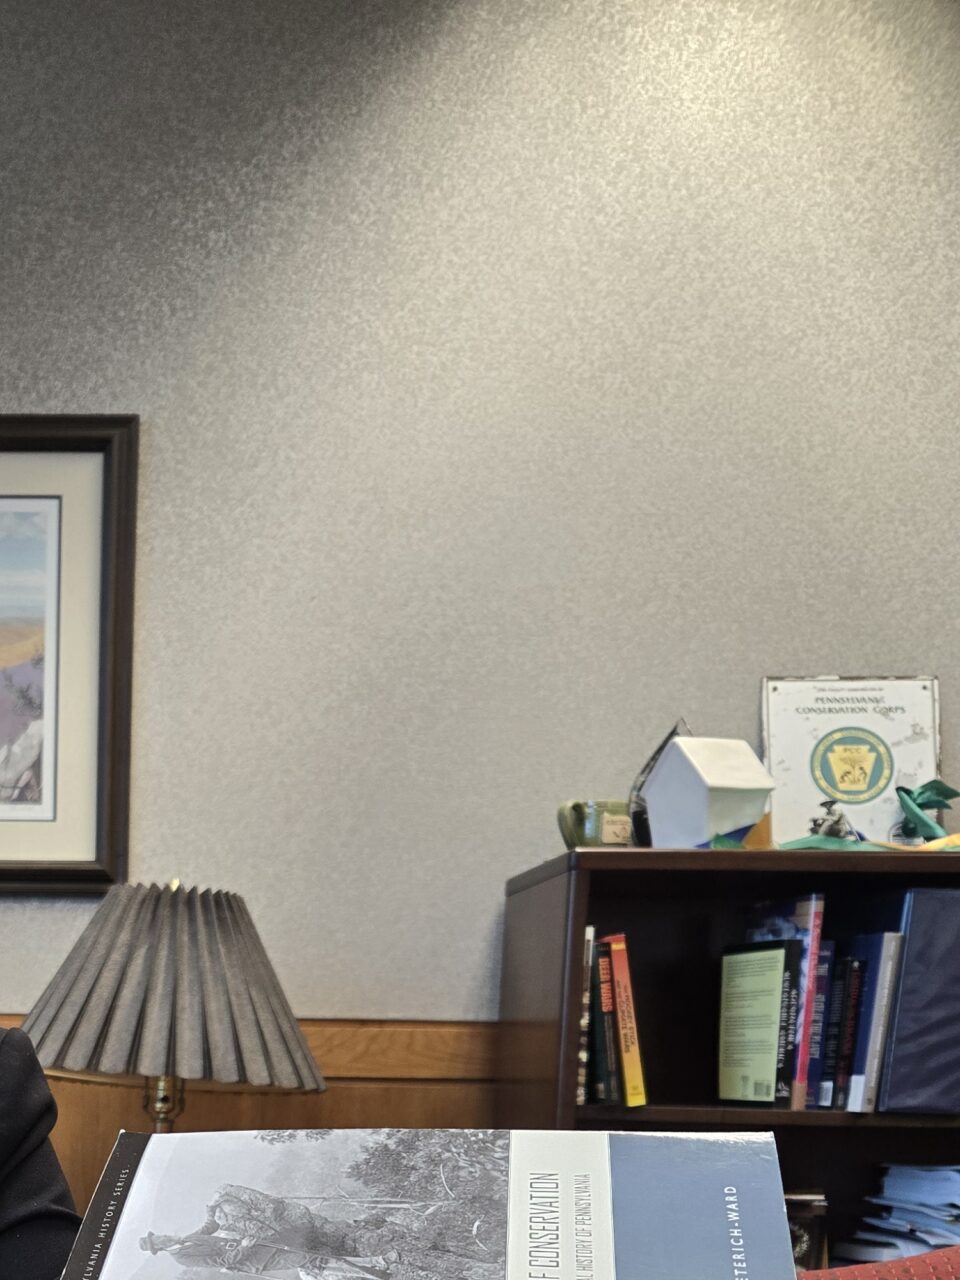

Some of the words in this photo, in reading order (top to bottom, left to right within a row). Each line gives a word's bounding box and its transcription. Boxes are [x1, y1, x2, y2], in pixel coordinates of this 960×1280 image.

[795, 706, 868, 714] CONSERVATION
[599, 957, 610, 981] DEER
[600, 982, 613, 1012] WARS
[98, 1200, 117, 1238] HISTORY
[113, 1169, 129, 1196] SERIES
[574, 1173, 592, 1226] PENNSYLVANIA
[529, 1173, 560, 1268] CONSERVATION
[575, 1227, 592, 1237] OF
[575, 1238, 593, 1272] HISTORY
